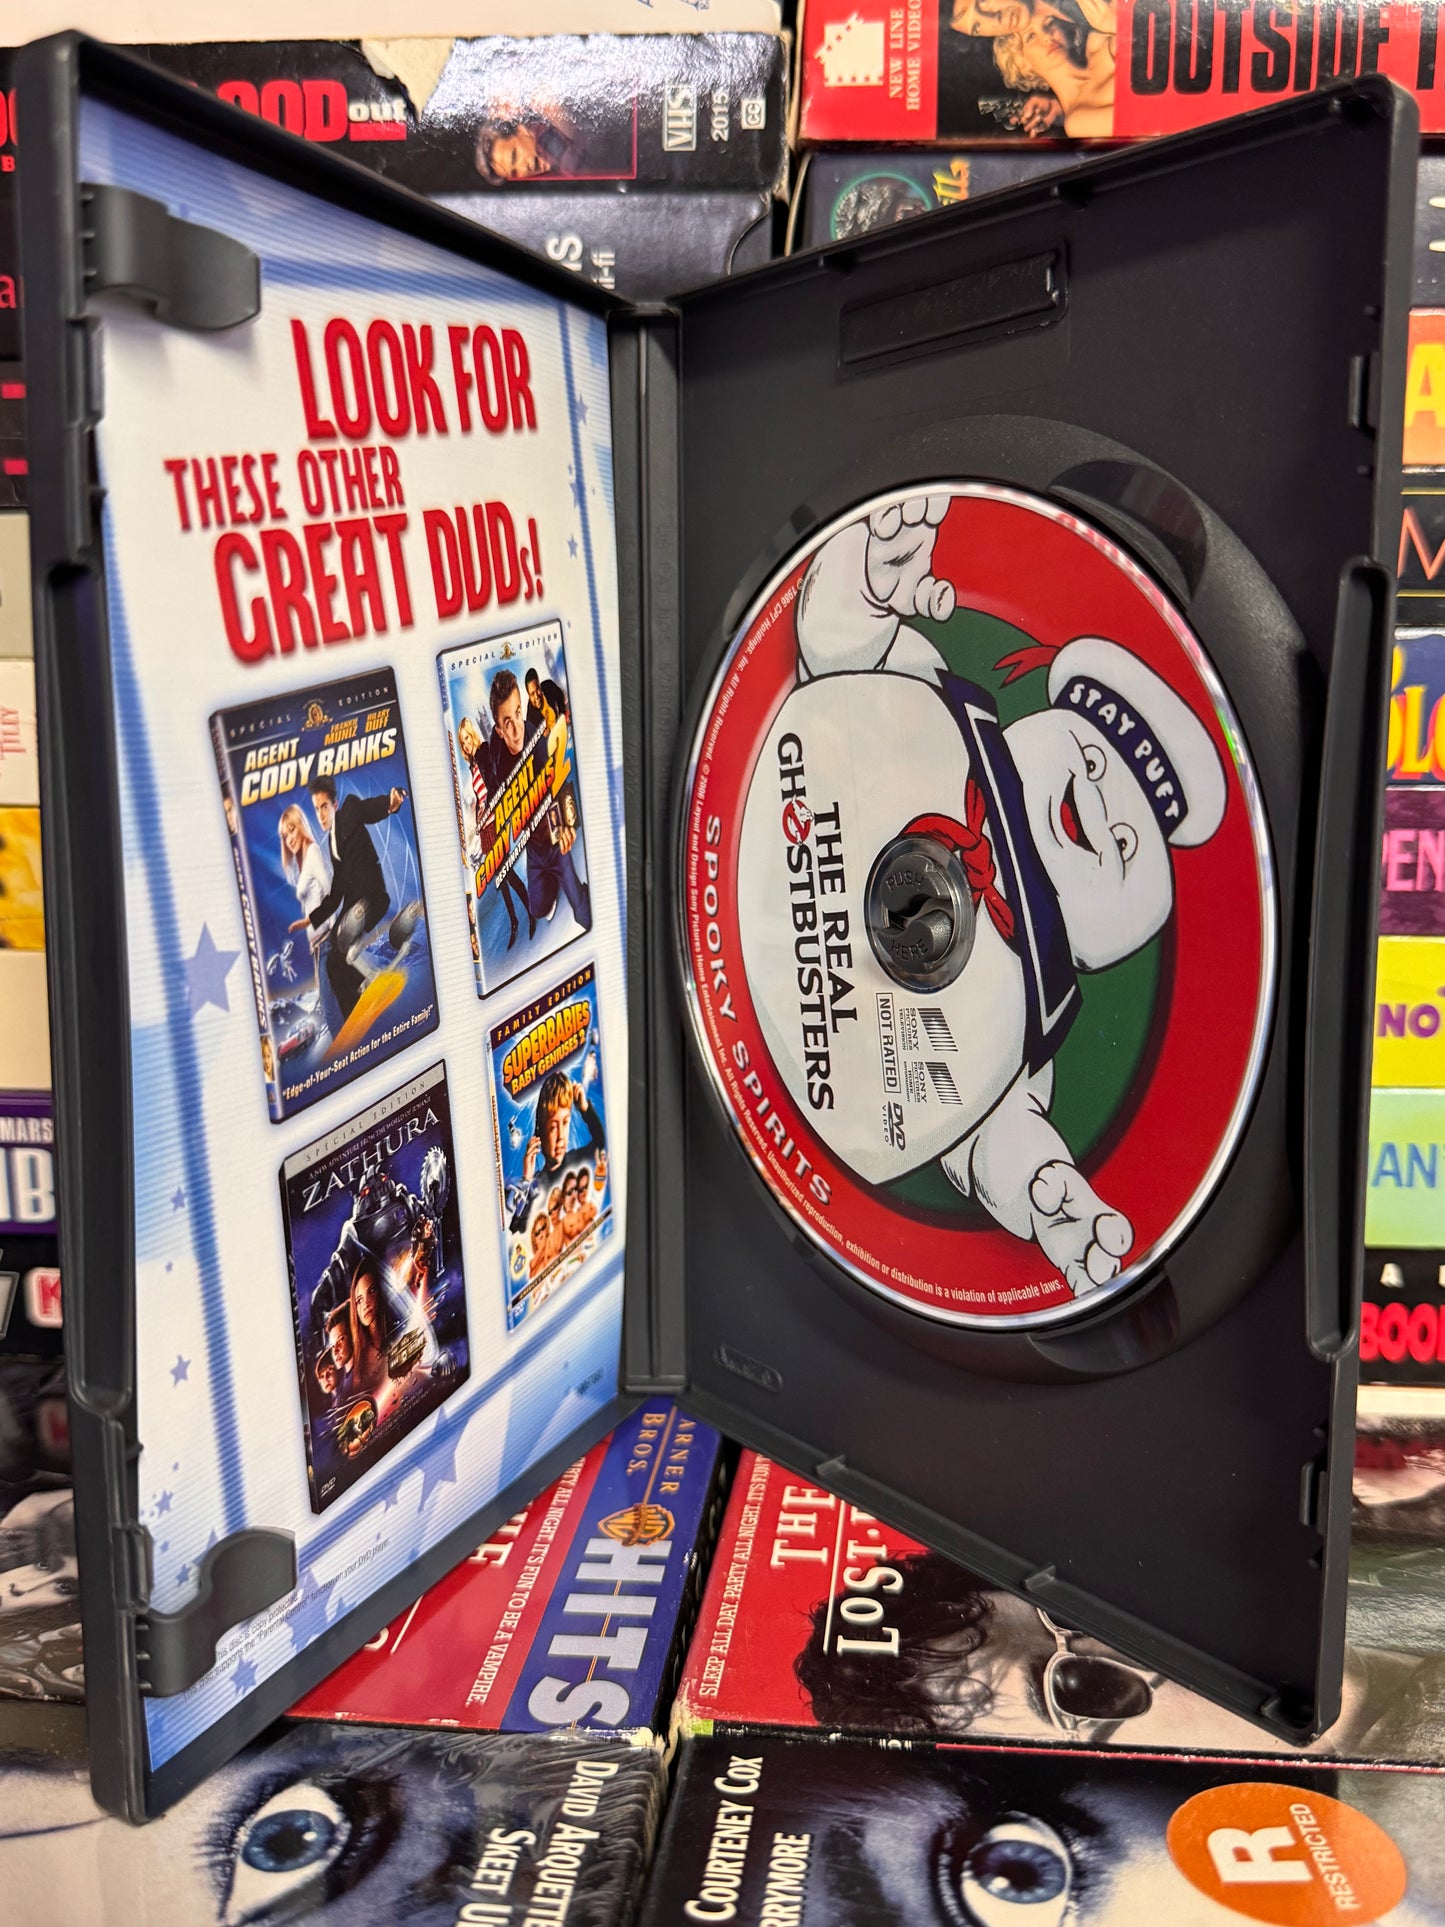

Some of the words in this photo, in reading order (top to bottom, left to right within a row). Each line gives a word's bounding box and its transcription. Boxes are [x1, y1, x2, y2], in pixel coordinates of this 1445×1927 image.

[890, 8, 904, 50] LINE
[907, 0, 923, 52] VIDEO
[889, 58, 904, 98] NEW
[906, 57, 922, 111] HOME
[667, 87, 694, 149] VHS
[291, 318, 448, 441] LOOK
[448, 323, 538, 434] FOR
[164, 453, 288, 532] THESE
[297, 446, 405, 516] OTHER
[214, 513, 413, 664] GREAT
[423, 501, 545, 620] DVDs!
[769, 603, 783, 623] CPT
[450, 652, 497, 671] SPECIAL
[519, 632, 559, 650] EDITION
[745, 618, 771, 655] Holdings,
[729, 673, 740, 690] All
[736, 656, 749, 672] Inc.
[229, 714, 292, 739] SPECIAL
[338, 686, 389, 707] EDITION
[718, 687, 734, 717] Rights
[324, 726, 358, 747] MUNIZ
[365, 716, 390, 733] DUFF
[1069, 683, 1136, 736] STAY
[1134, 739, 1180, 819] PUFT
[241, 753, 316, 807] CODY
[316, 727, 397, 778] BANKS
[244, 737, 300, 774] AGENT
[475, 822, 511, 900] CODY
[511, 756, 555, 841] BANKS
[547, 714, 571, 798] 2
[495, 755, 535, 833] AGENT
[693, 801, 703, 833] Layout
[495, 828, 531, 889] DESTINATION
[531, 794, 552, 833] LONDON
[814, 802, 846, 896] THE
[689, 854, 698, 886] Design
[886, 870, 925, 893] PUSH
[690, 888, 699, 913] Sony
[692, 914, 702, 953] Pictures
[890, 939, 928, 961] HERE
[696, 954, 706, 982] Home
[822, 909, 858, 1034] REAL
[497, 1005, 541, 1041] FAMILY
[547, 970, 592, 1007] EDITION
[701, 983, 722, 1049] Entertainment
[704, 814, 738, 1022] SPOOKY
[732, 1040, 832, 1205] SPIRITS
[879, 998, 893, 1032] NOT
[350, 1046, 370, 1062] Action
[371, 1037, 380, 1050] for
[382, 1031, 391, 1044] the
[393, 1022, 411, 1037] Entire
[503, 1000, 591, 1084] SUPERBABIES
[910, 1008, 919, 1051] SONY
[511, 1065, 537, 1096] BABY
[537, 1033, 579, 1075] GENIUSES
[578, 1028, 587, 1045] 2
[724, 1067, 735, 1082] All
[883, 1034, 898, 1088] RATED
[731, 1080, 746, 1111] Rights
[918, 1062, 927, 1103] SONY
[305, 1121, 364, 1162] SPECIAL
[372, 1081, 427, 1120] EDITION
[743, 1109, 768, 1153] Reserved.
[892, 1102, 906, 1150] DVD
[301, 1106, 441, 1213] ZATHURA
[767, 1150, 804, 1203] Unauthorized
[803, 1199, 844, 1246] reproduction,
[845, 1240, 880, 1270] exhibition
[881, 1264, 890, 1276] or
[890, 1267, 934, 1296] distribution
[935, 1284, 943, 1297] is
[944, 1287, 950, 1298] a
[951, 1286, 987, 1303] violation
[988, 1288, 996, 1303] of
[997, 1281, 1041, 1305] applicable
[1041, 1277, 1065, 1294] laws.
[626, 1413, 667, 1476] BROS.
[751, 1463, 771, 1482] FUN
[551, 1486, 574, 1507] ALL
[540, 1506, 566, 1541] NIGHT.
[738, 1502, 761, 1538] NIGHT.
[770, 1485, 835, 1570] THE
[527, 1543, 551, 1566] IT'S
[734, 1536, 753, 1560] ALL
[516, 1566, 540, 1591] FUN
[723, 1559, 747, 1600] PARTY
[508, 1591, 530, 1610] TO
[719, 1600, 741, 1624] DAY.
[836, 1540, 904, 1658] LOST
[493, 1632, 513, 1641] A
[500, 1611, 521, 1629] BE
[527, 1537, 673, 1727] HITS
[710, 1622, 733, 1655] ALL
[464, 1643, 510, 1709] VAMPIRE.
[699, 1655, 726, 1698] SLEEP
[561, 1760, 620, 1818] DAVID
[714, 1755, 764, 1795] COX
[470, 1828, 537, 1895] SKEET
[684, 1800, 755, 1921] COURTENEY
[1207, 1825, 1313, 1884] R
[1289, 1802, 1362, 1912] RESTRICTED
